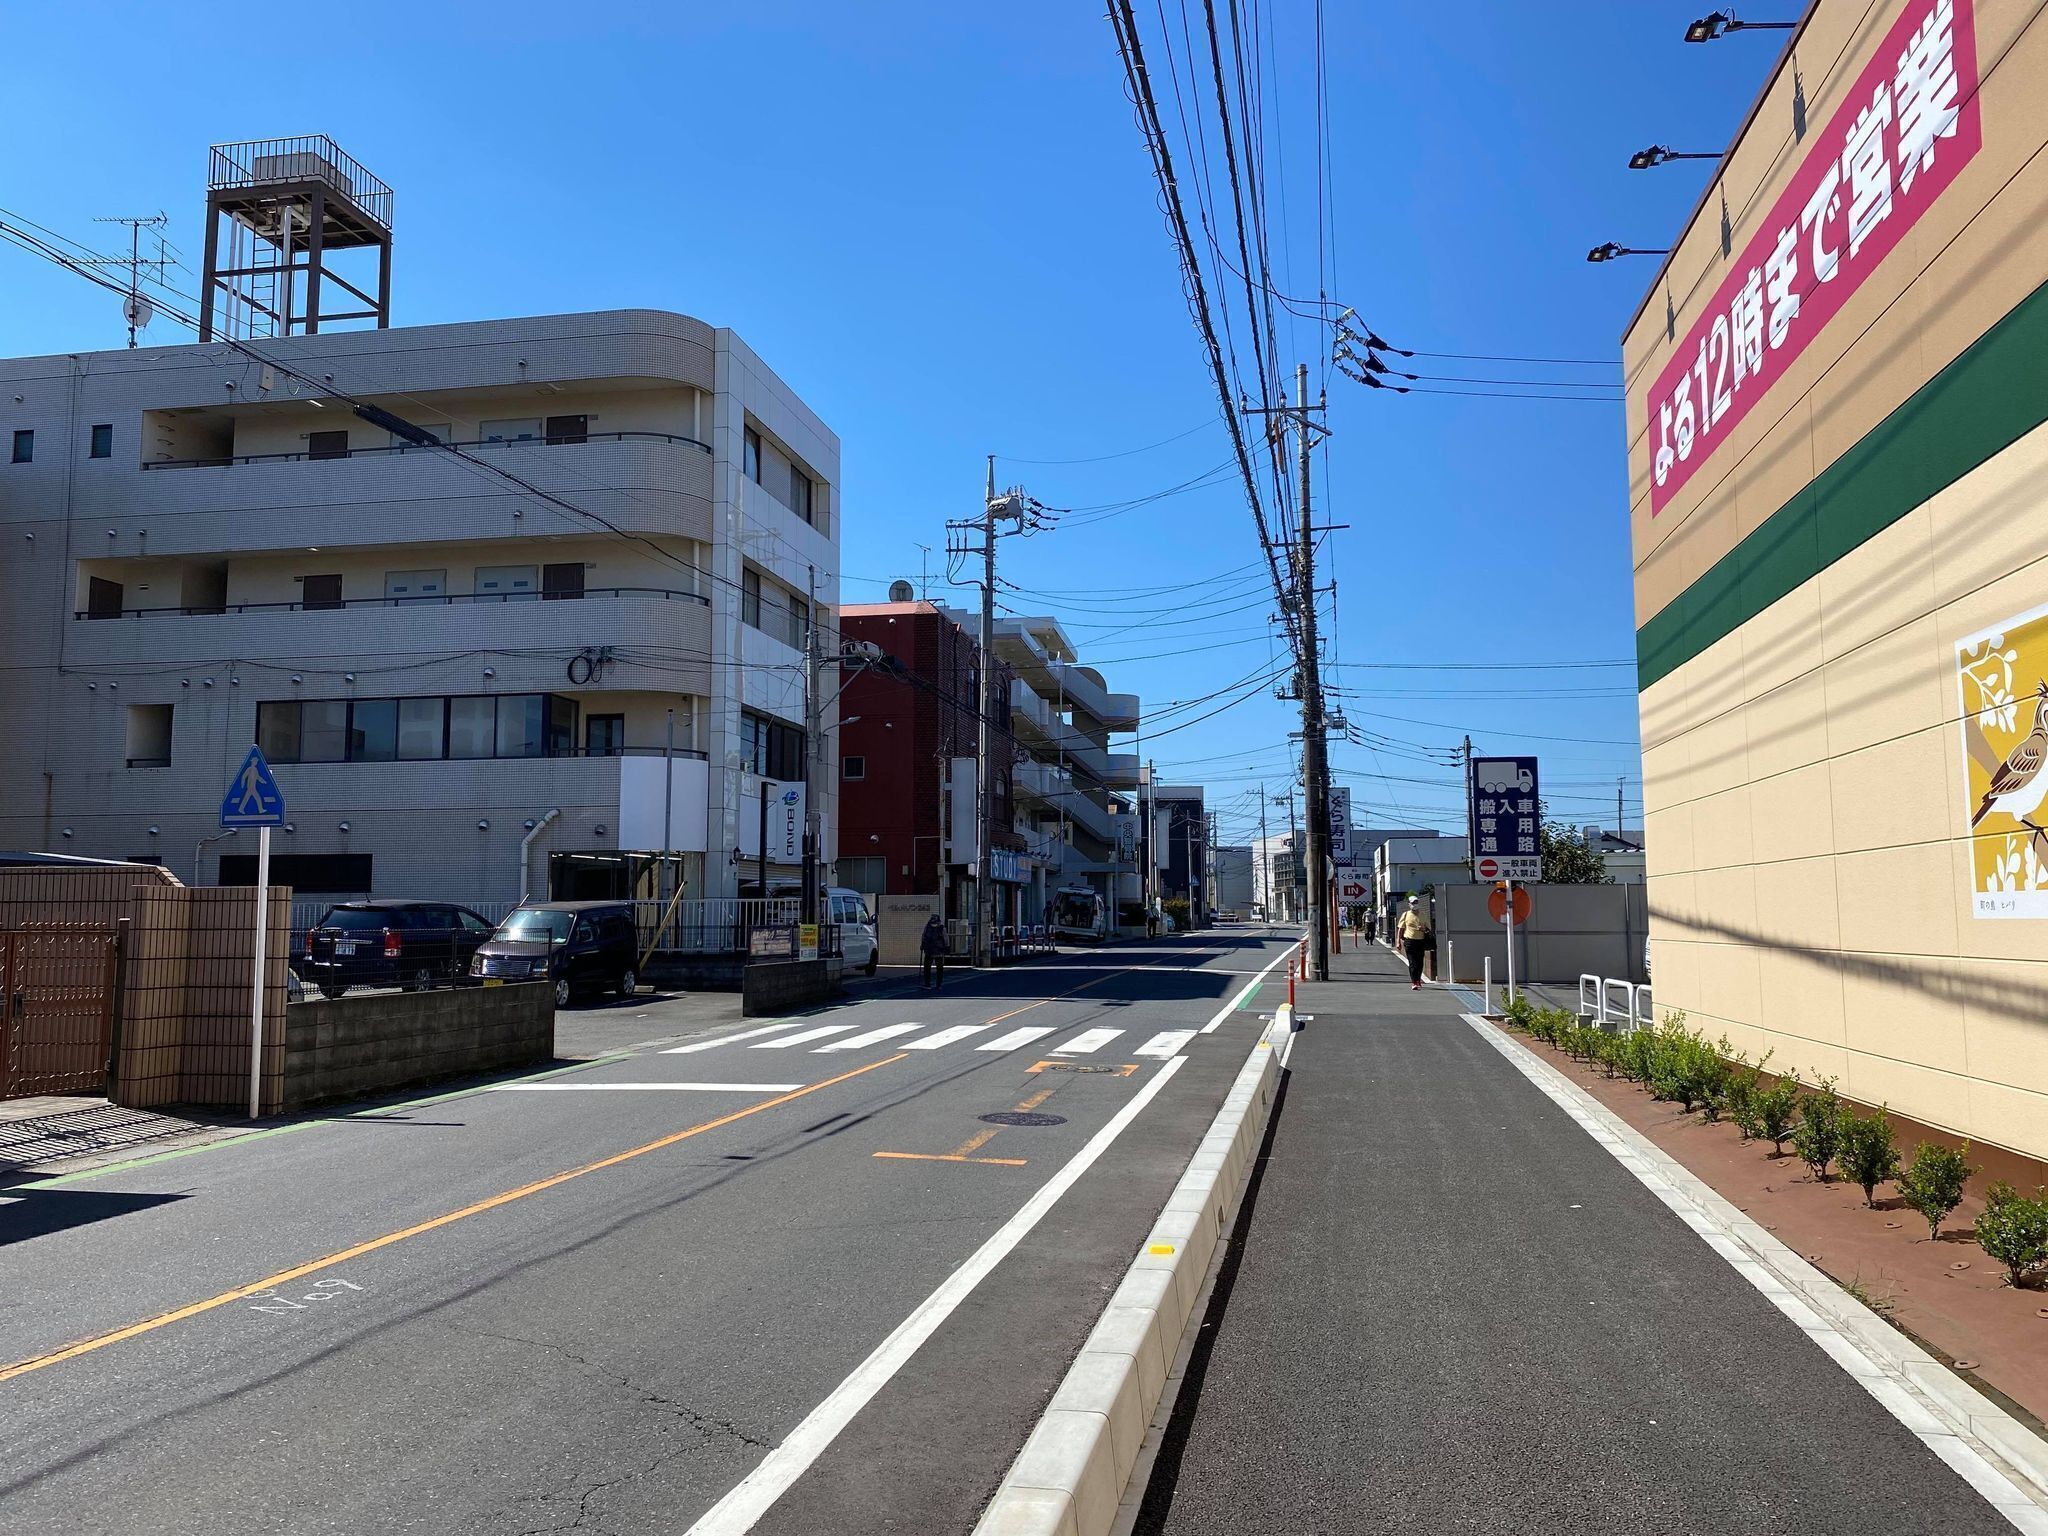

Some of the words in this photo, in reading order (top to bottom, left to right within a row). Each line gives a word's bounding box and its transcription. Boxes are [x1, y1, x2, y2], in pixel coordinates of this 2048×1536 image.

[1654, 0, 1960, 486] よる12時まで営業
[1479, 799, 1534, 815] 搬入車
[1331, 795, 1345, 851] くら寿司
[786, 808, 795, 856] BOND
[1502, 859, 1538, 868] 一般車両
[1502, 869, 1538, 878] 進入禁止
[1347, 886, 1359, 895] IN
